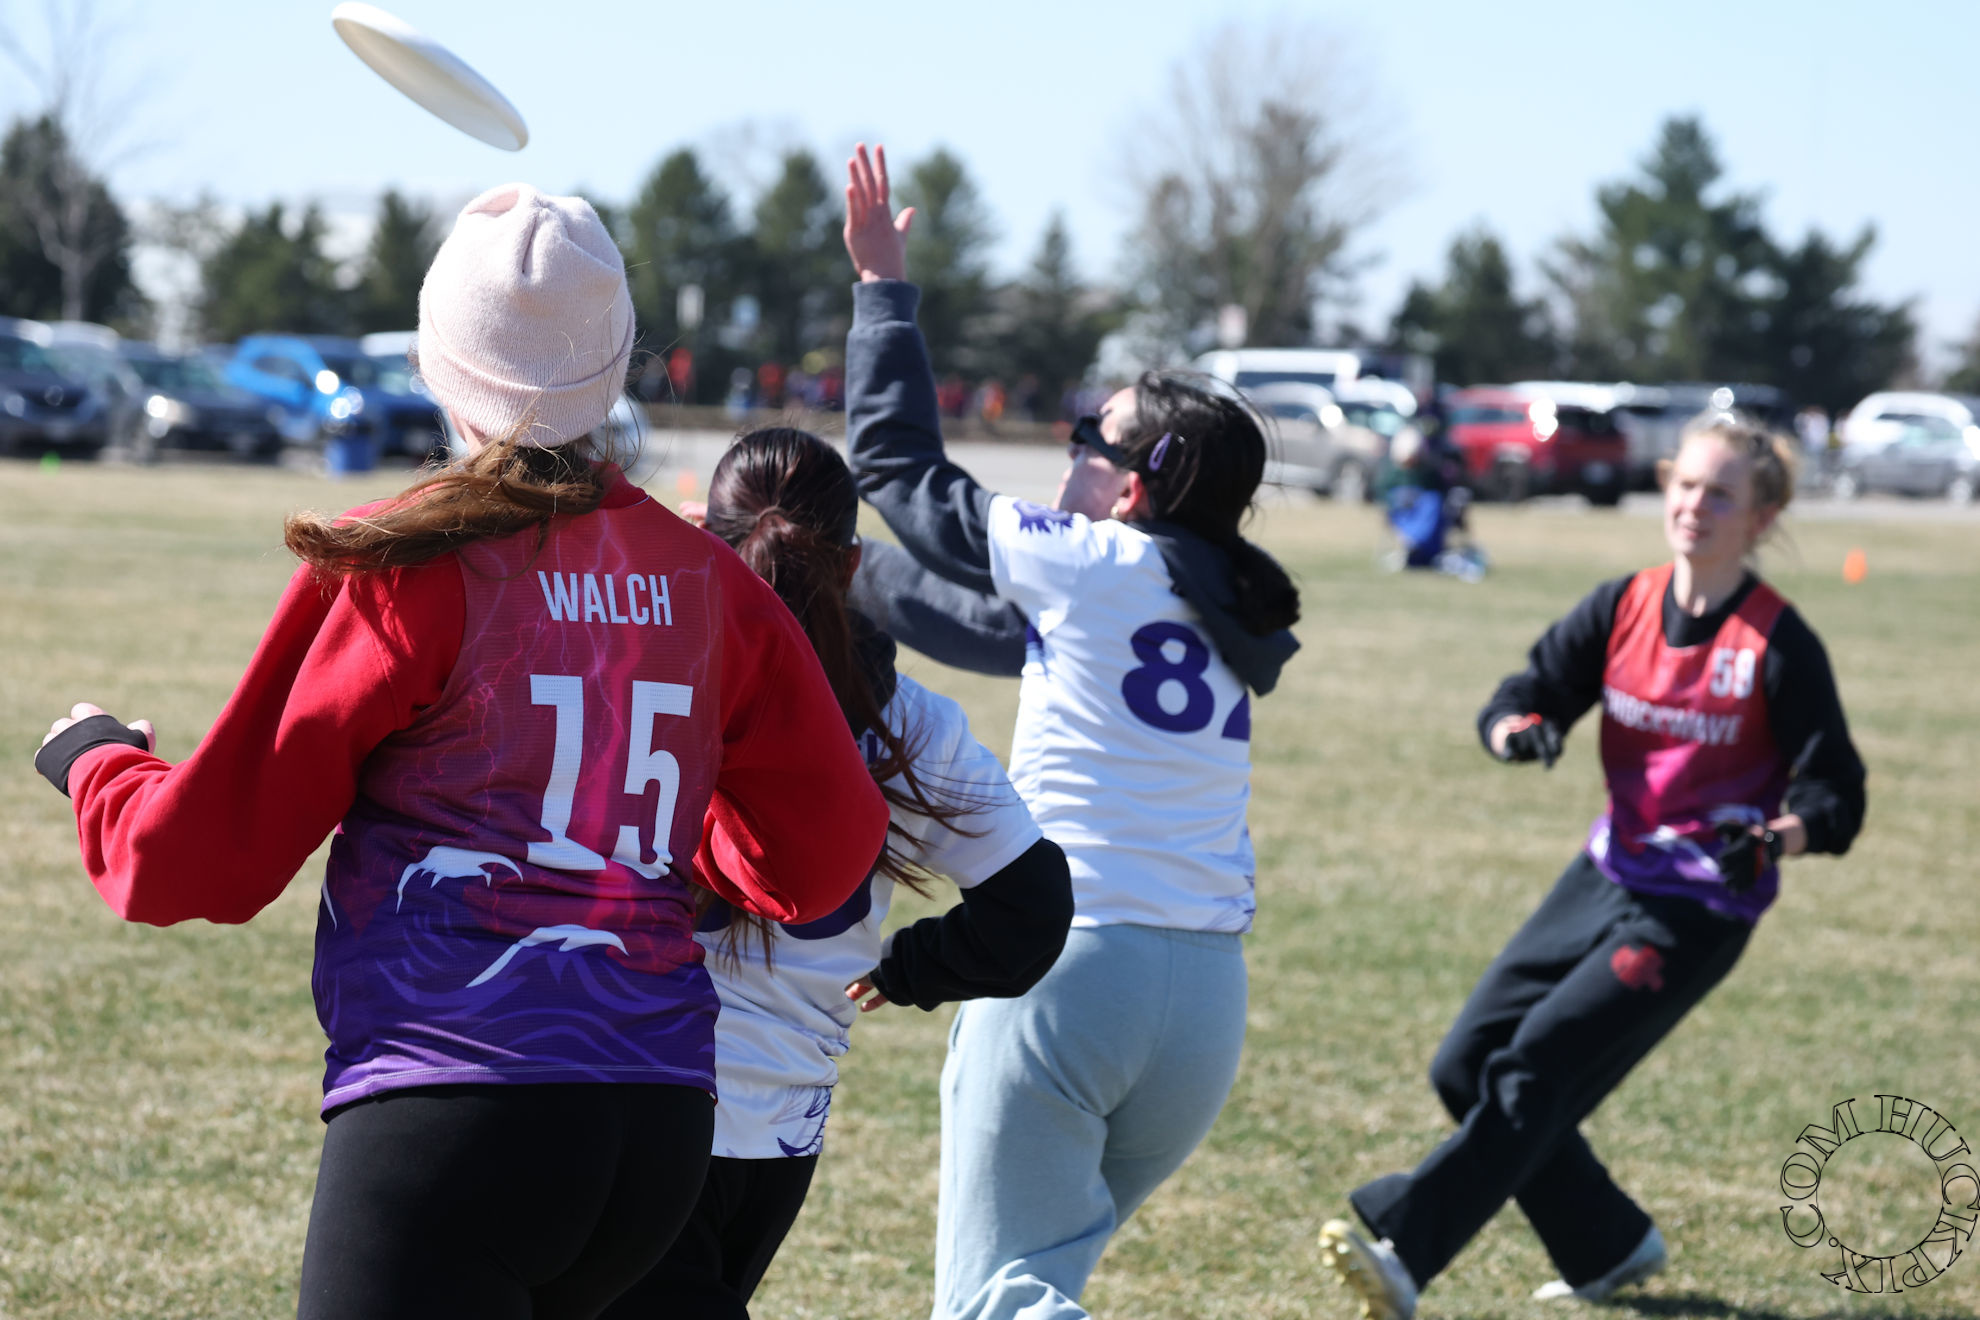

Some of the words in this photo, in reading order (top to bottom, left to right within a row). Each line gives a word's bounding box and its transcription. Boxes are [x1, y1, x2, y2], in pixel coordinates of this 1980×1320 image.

[537, 570, 673, 627] WALCH
[1709, 647, 1757, 699] 59
[527, 674, 693, 880] 15
